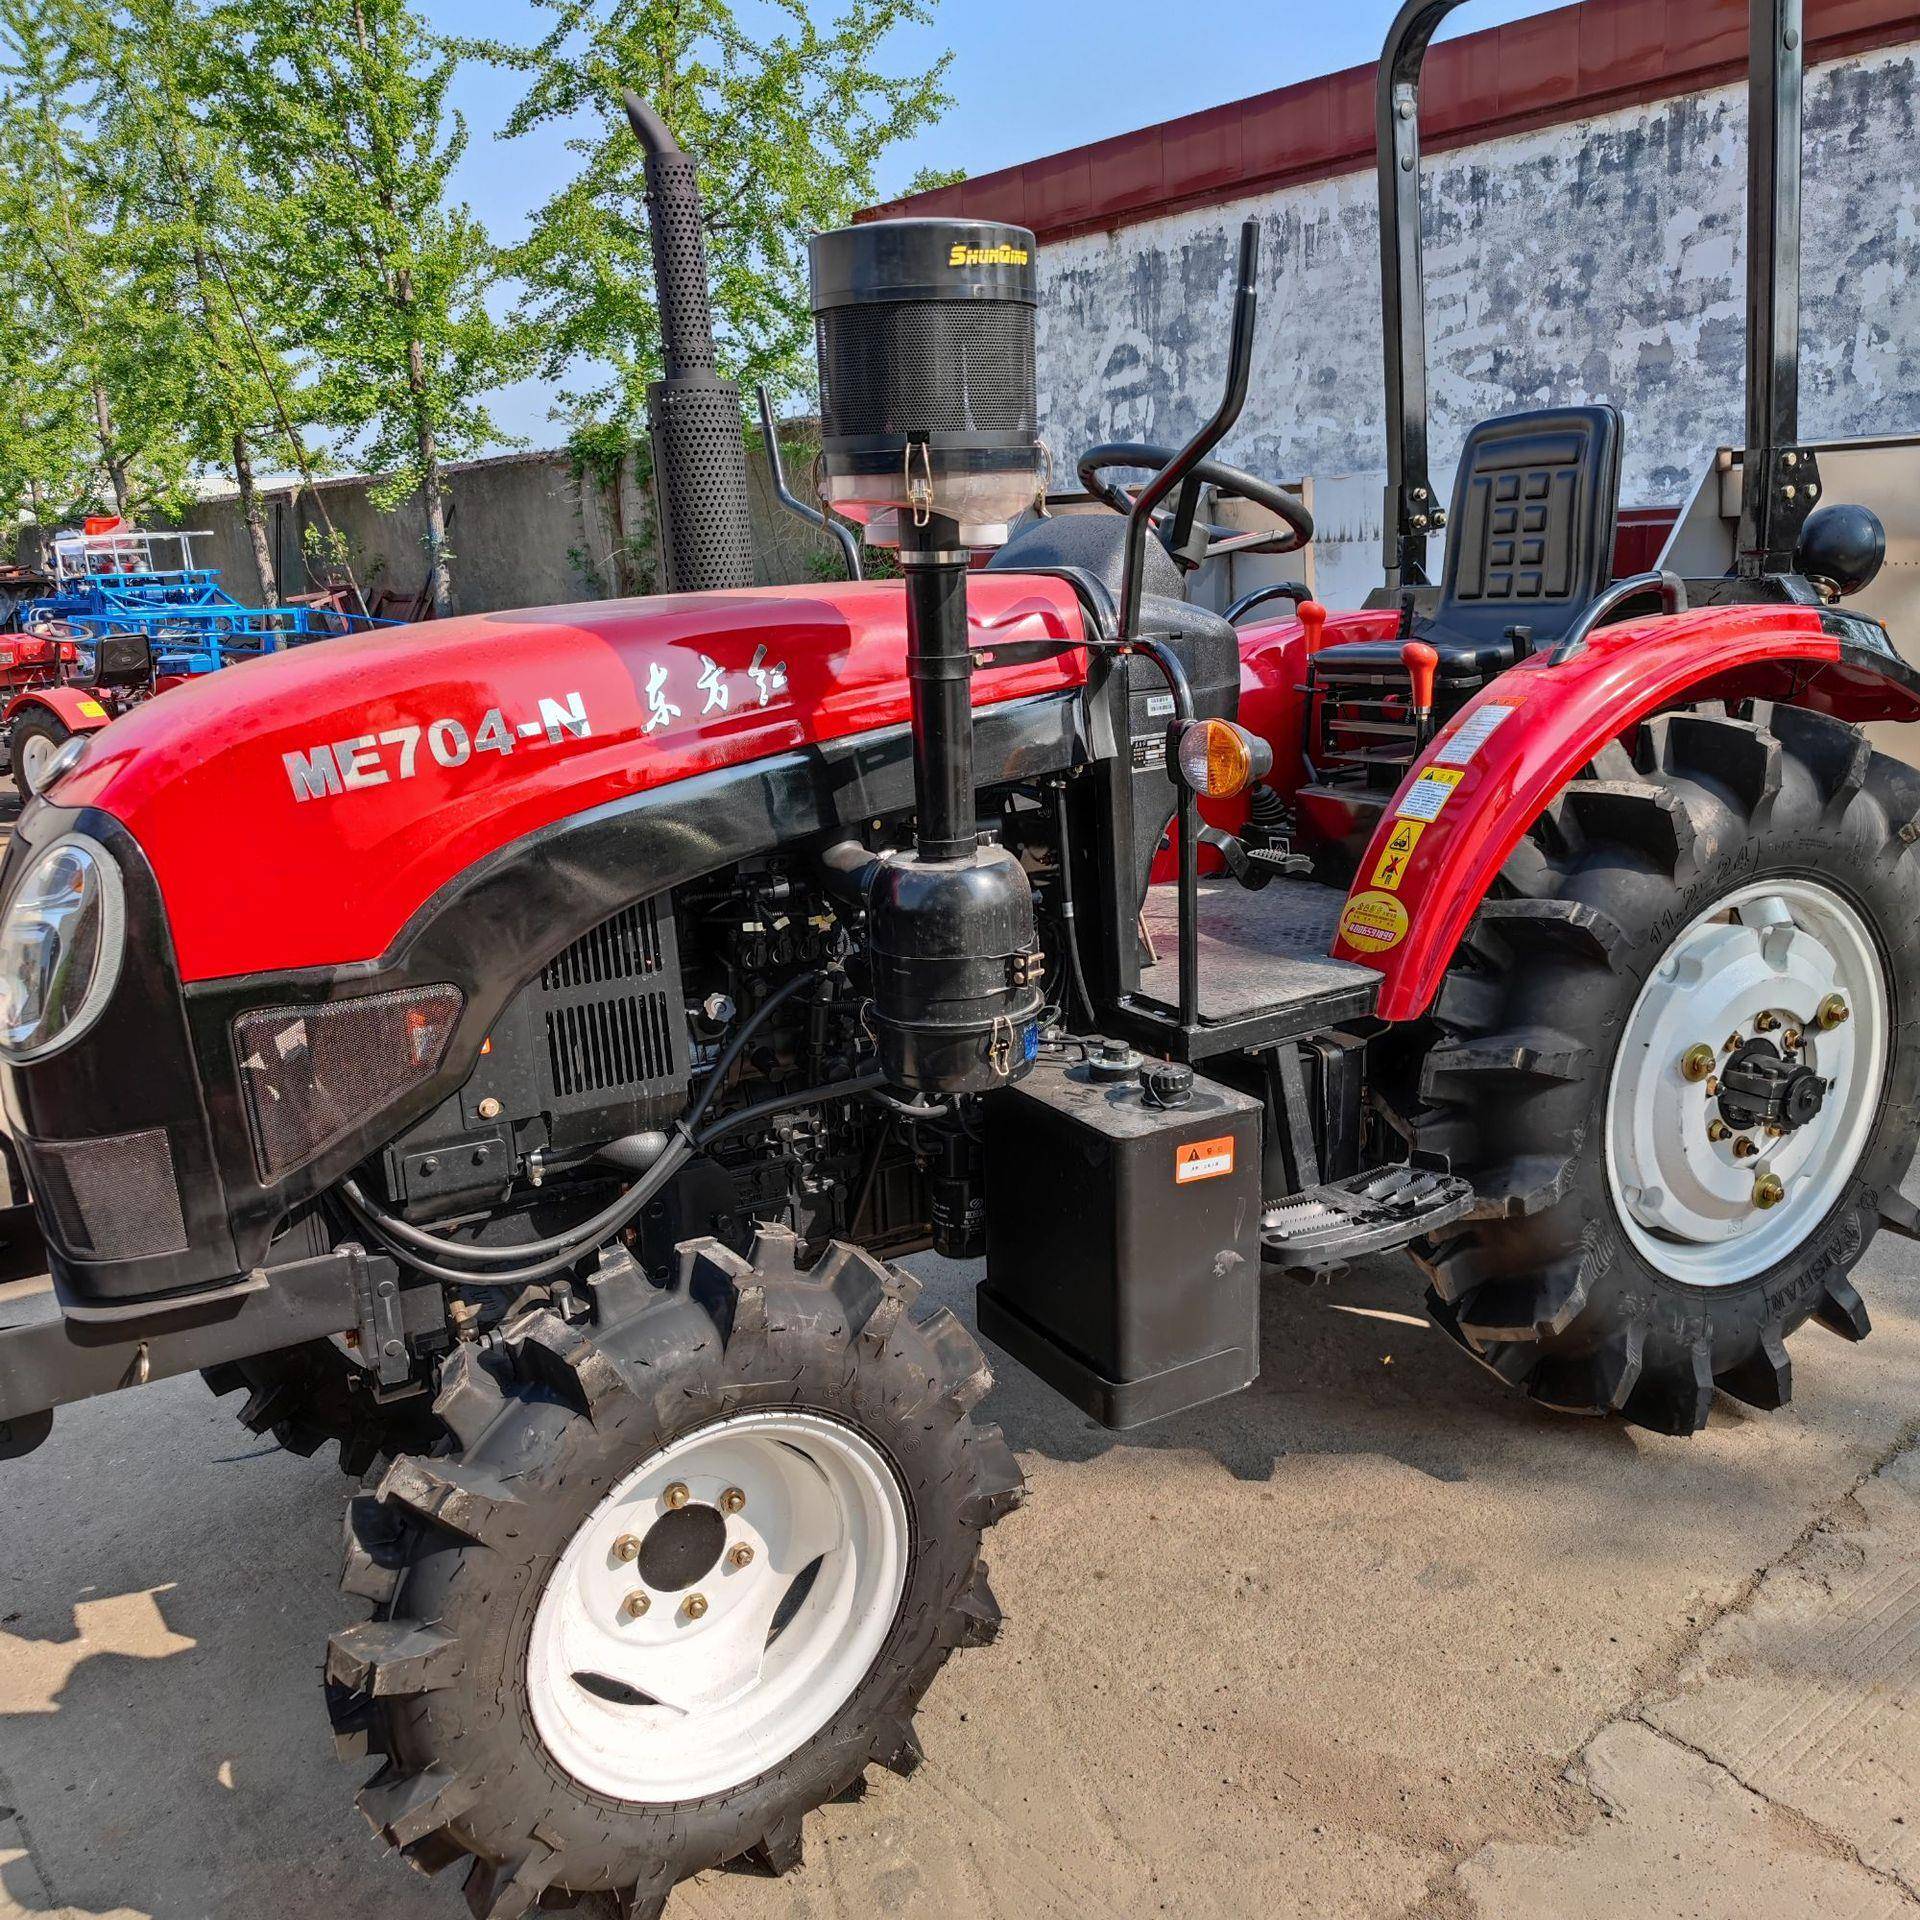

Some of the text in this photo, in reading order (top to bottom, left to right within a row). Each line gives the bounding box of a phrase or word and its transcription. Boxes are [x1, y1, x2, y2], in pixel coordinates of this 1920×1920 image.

[642, 643, 788, 733] 东方红
[282, 691, 593, 803] ME704-N
